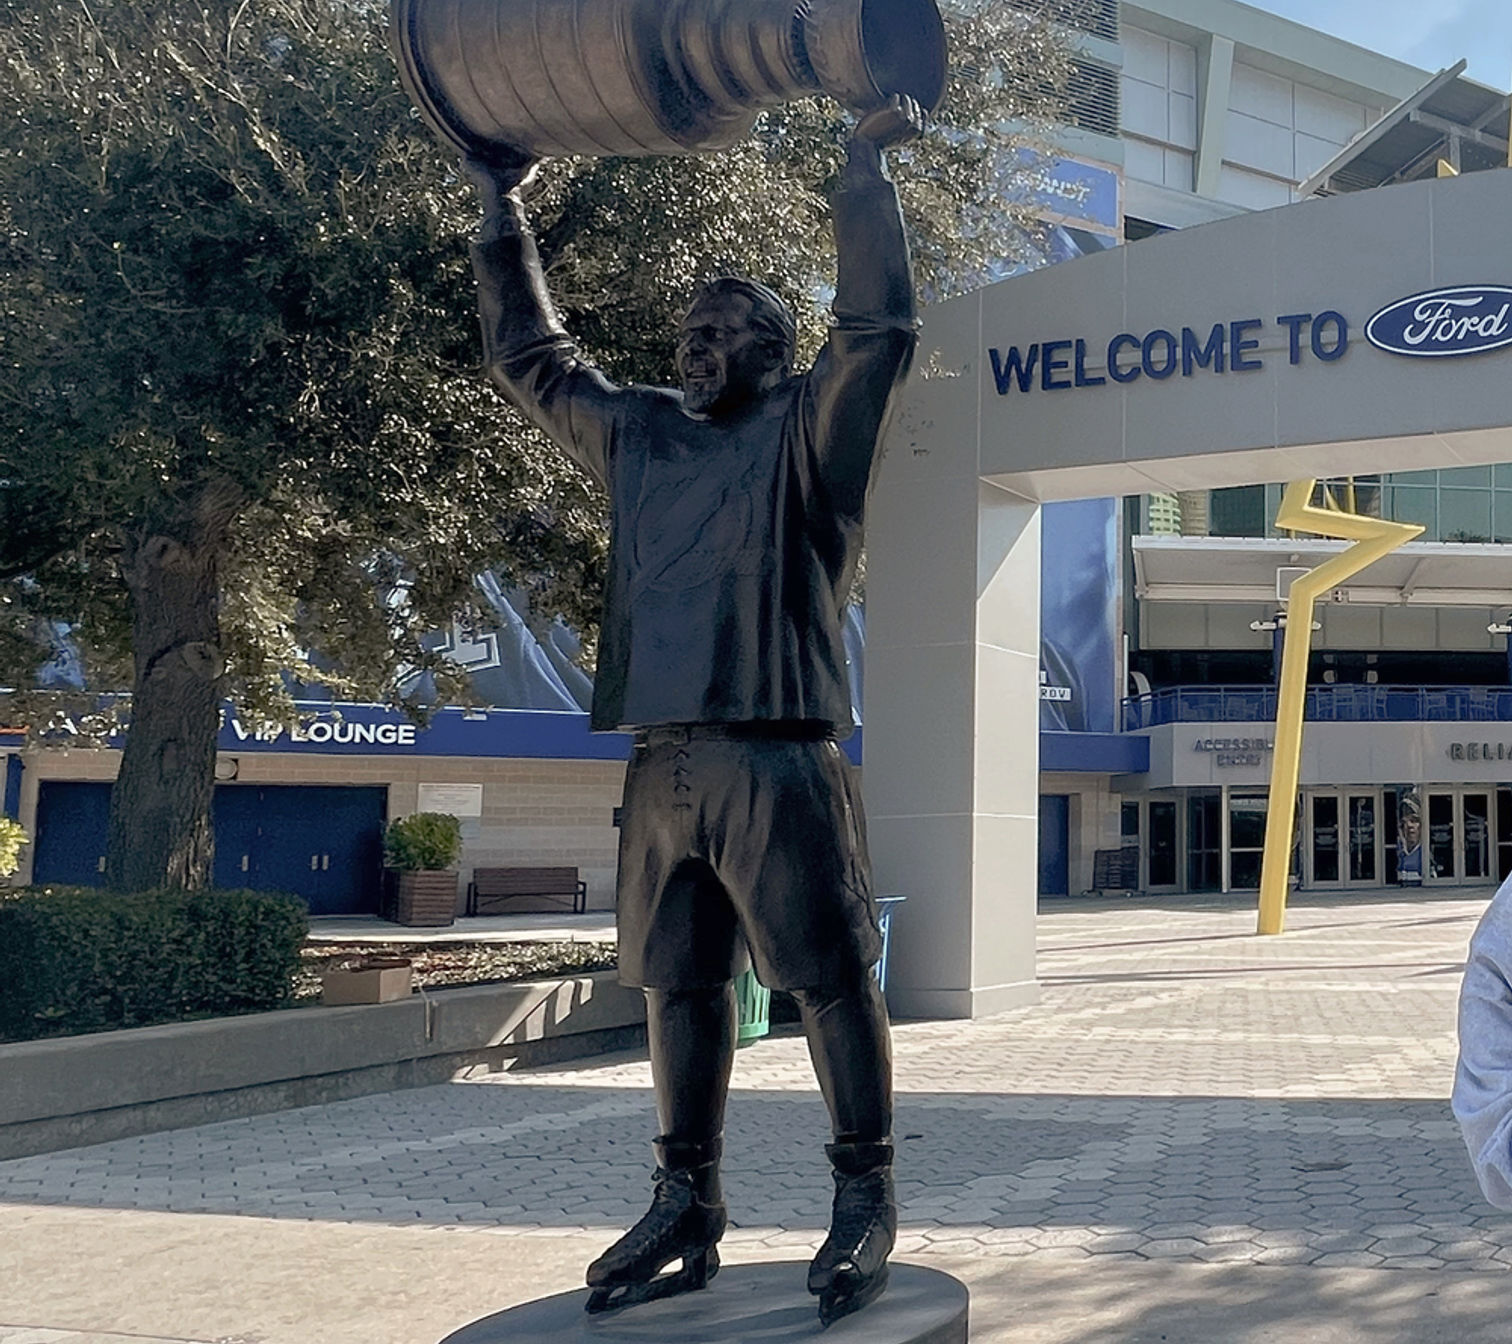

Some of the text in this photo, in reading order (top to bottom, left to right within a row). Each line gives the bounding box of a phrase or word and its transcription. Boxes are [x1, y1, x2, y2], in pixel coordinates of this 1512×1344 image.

[989, 318, 1263, 396] WELCOME
[1276, 309, 1349, 367] TO
[1403, 296, 1510, 346] Ford
[1040, 688, 1066, 698] ROV
[232, 719, 284, 743] VIP
[291, 721, 416, 745] LOUNGE
[1194, 739, 1274, 753] ACCESSIBL
